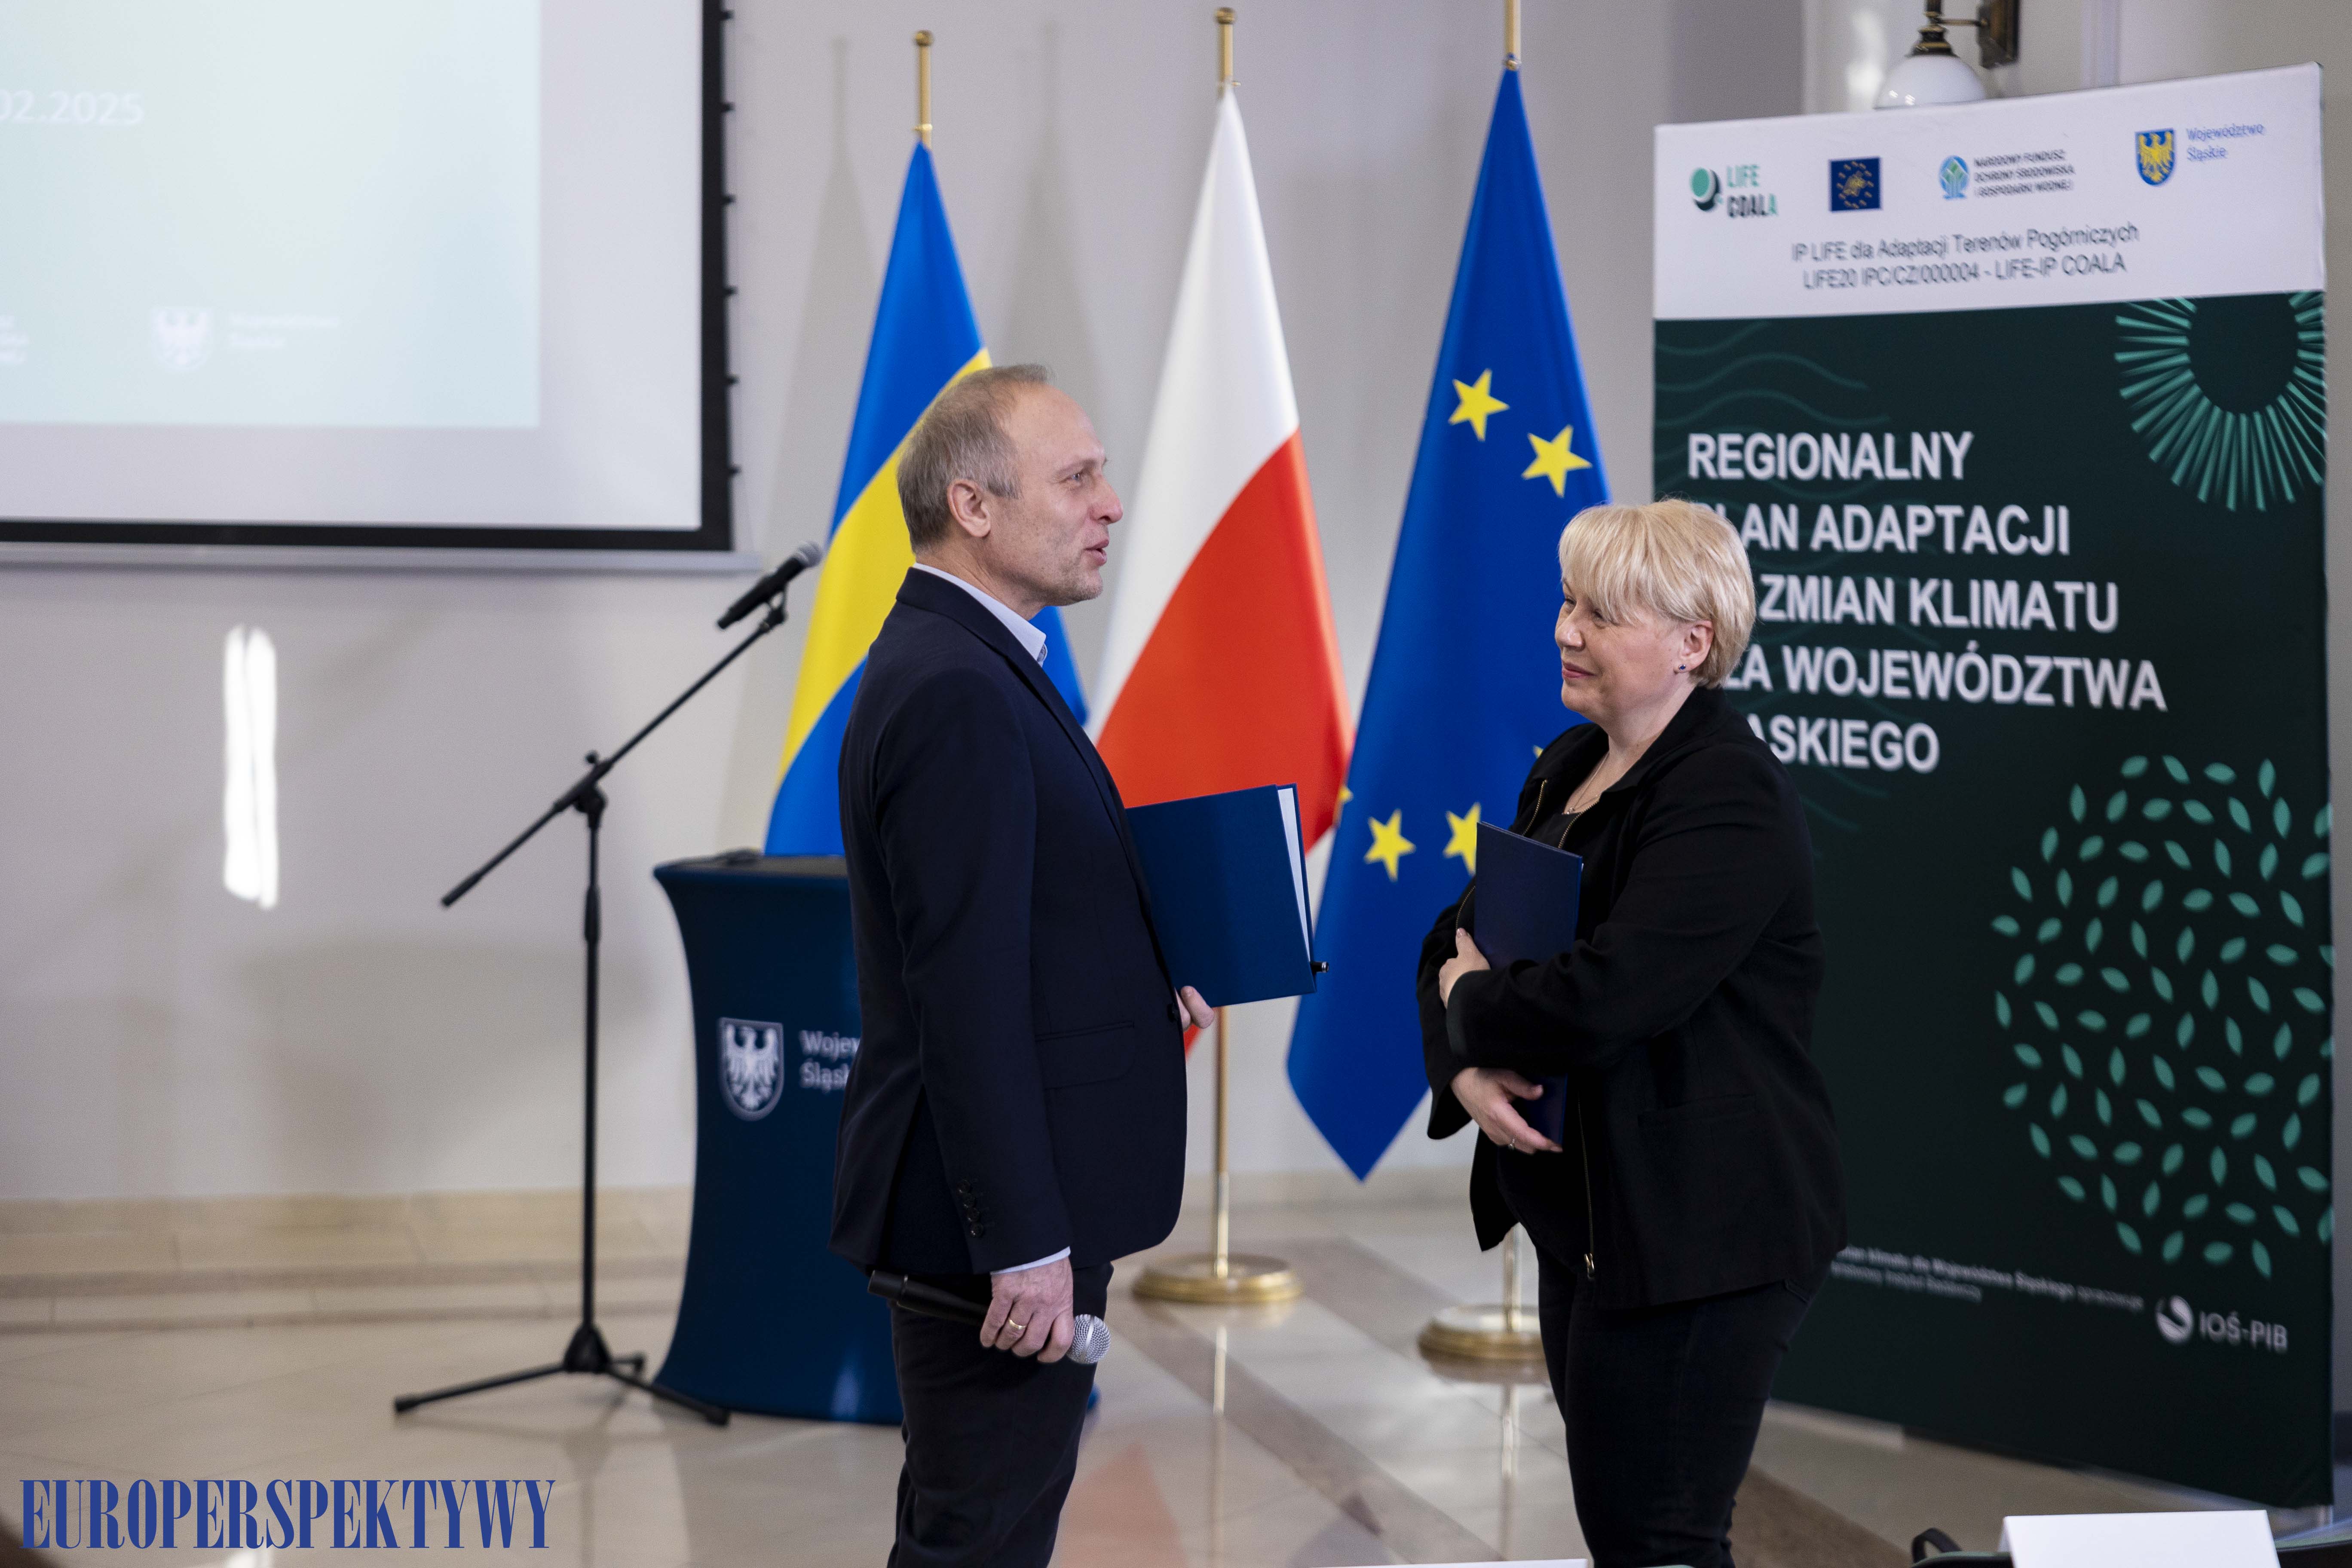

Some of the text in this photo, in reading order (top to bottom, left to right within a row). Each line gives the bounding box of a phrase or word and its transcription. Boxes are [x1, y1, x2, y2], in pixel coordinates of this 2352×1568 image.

[2186, 123, 2264, 141] Województwo
[1726, 164, 1761, 187] LIFE
[1727, 193, 1778, 217] COALA
[1792, 221, 2140, 261] IP LIFE dla Adaptacji Terenów Pogórniczych
[1804, 267, 1858, 289] LIFE20
[2062, 252, 2127, 276] COALA
[1687, 431, 1974, 481] REGIONALNY
[1809, 503, 2071, 556] ADAPTACJI
[1758, 573, 2119, 634] ZMIAN KLIMATU
[1782, 640, 2168, 713] WOJEWÓDZTWA
[2199, 1309, 2289, 1353] IOŚ-PIB
